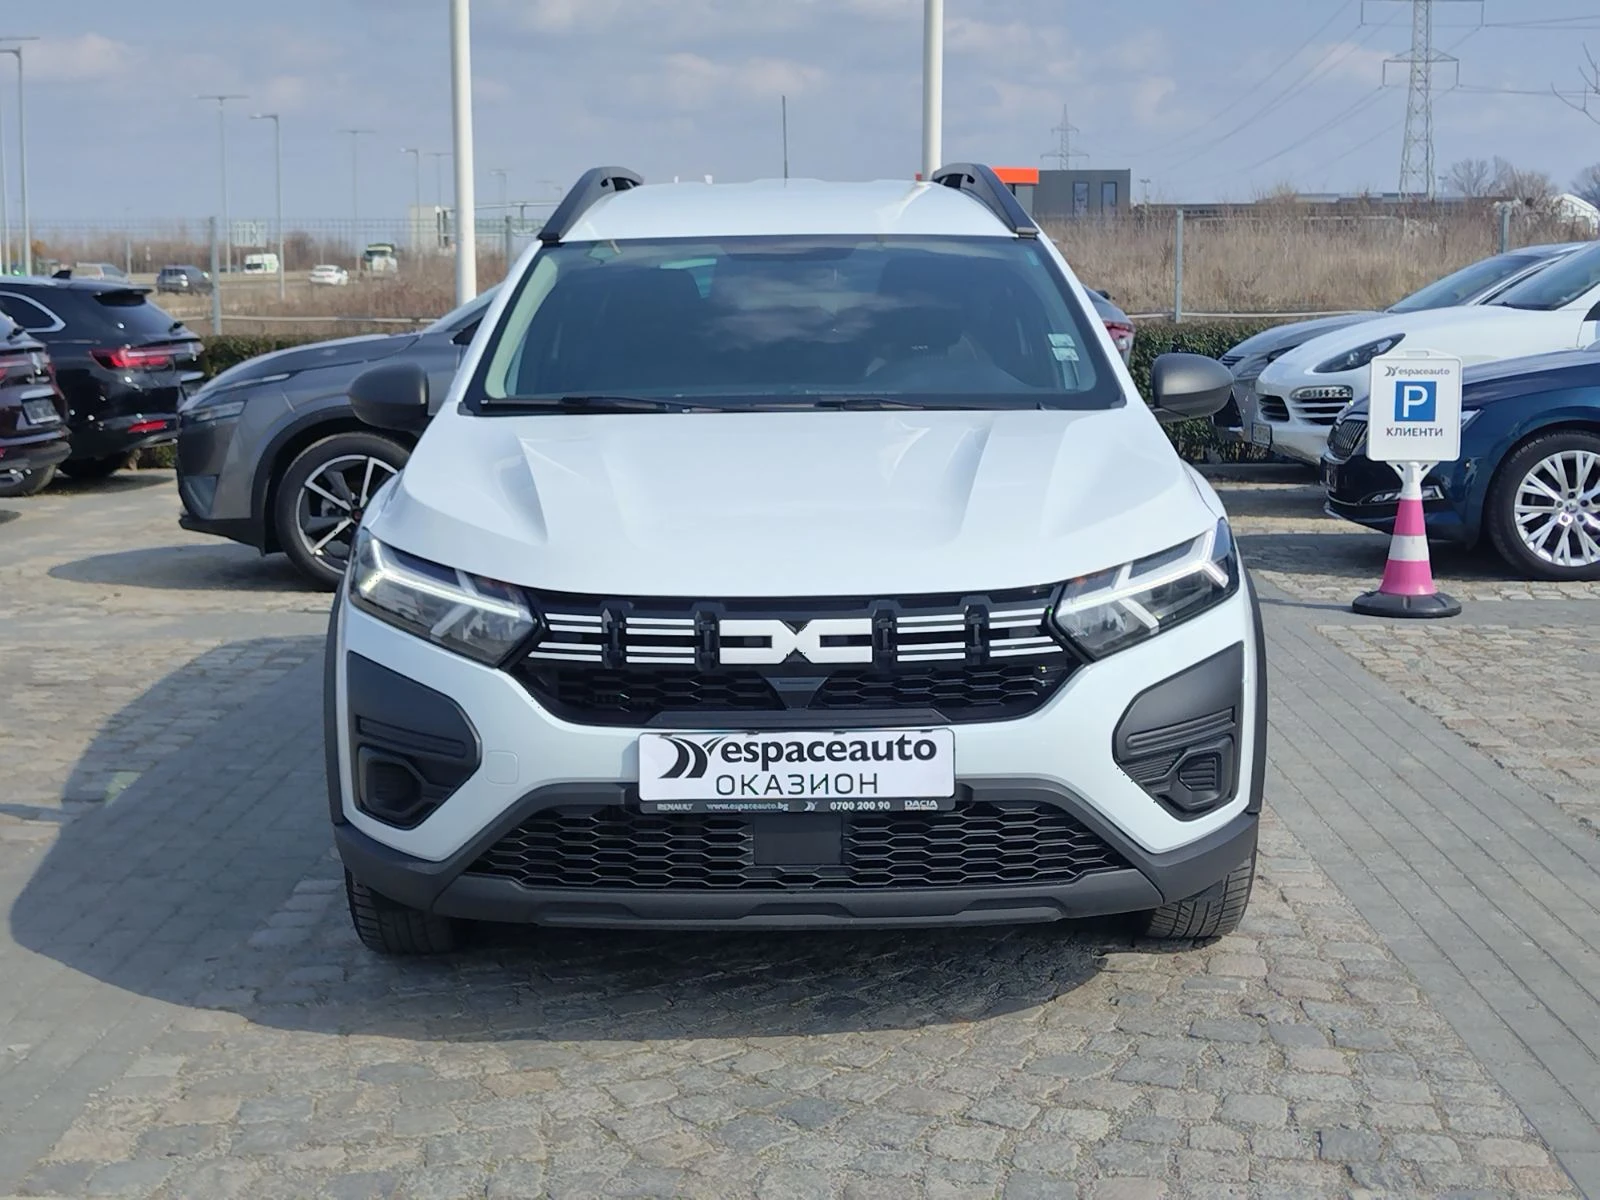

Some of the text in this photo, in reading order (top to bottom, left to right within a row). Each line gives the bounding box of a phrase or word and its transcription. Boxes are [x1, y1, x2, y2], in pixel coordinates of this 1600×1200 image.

[1398, 367, 1450, 377] espaceauto
[1403, 385, 1428, 418] P
[1386, 427, 1443, 437] КЛИЕНТИ
[720, 733, 937, 771] espaceauto
[715, 773, 878, 796] ОКАЗИОН
[706, 803, 789, 812] www.espaceauto.bg
[829, 801, 855, 811] 0700
[857, 801, 875, 811] 200
[877, 801, 891, 810] 90
[904, 800, 938, 809] DACIA
